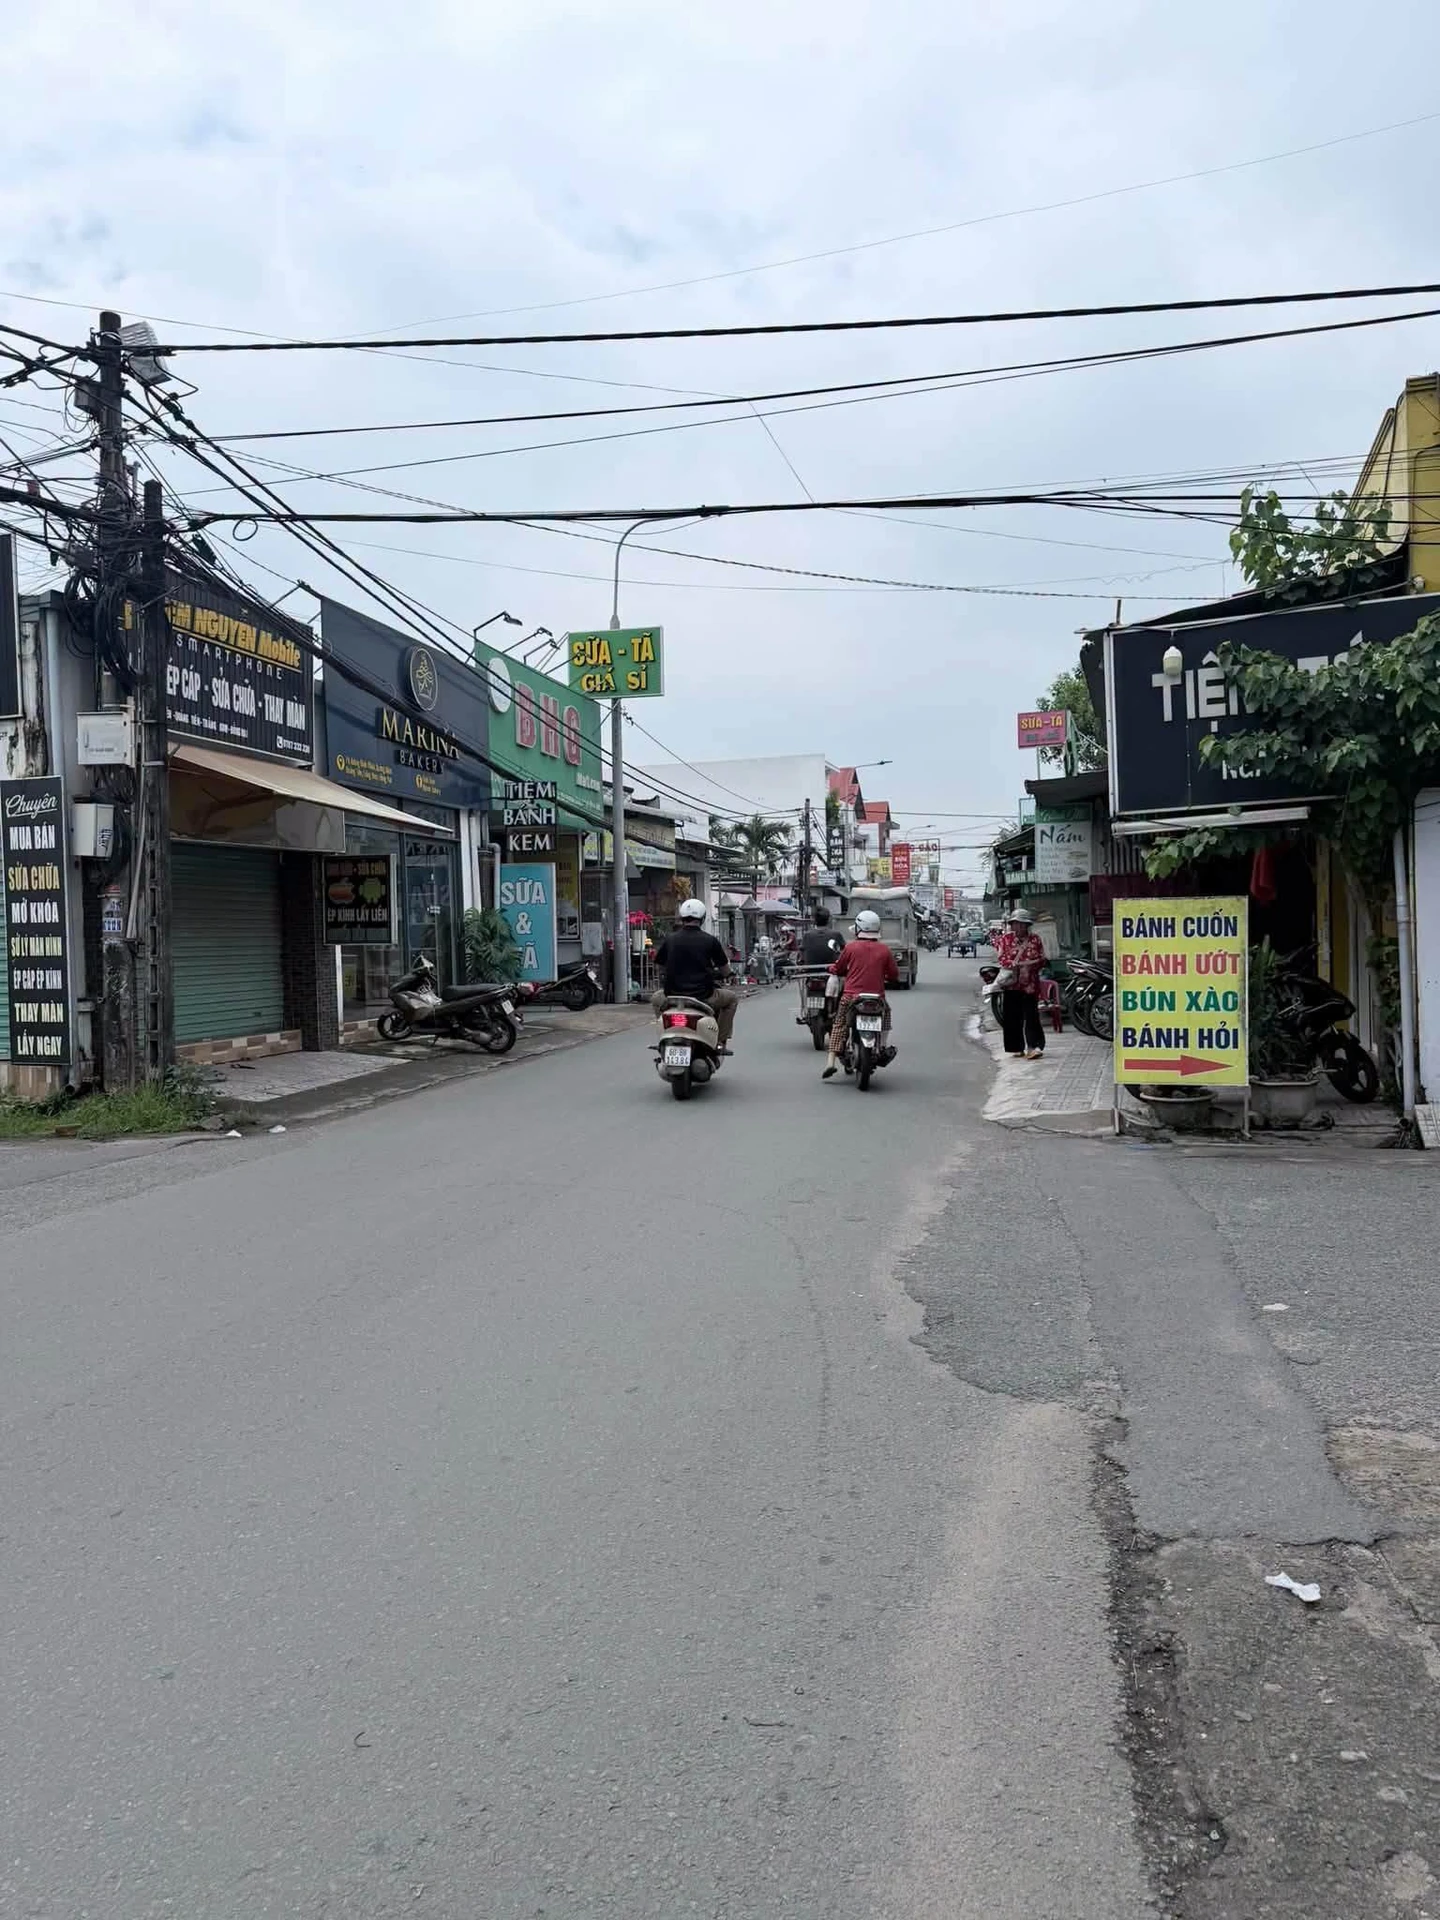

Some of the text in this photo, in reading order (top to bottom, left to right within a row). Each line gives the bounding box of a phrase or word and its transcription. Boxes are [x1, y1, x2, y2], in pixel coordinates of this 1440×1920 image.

[258, 629, 301, 667] Mobile
[572, 636, 611, 667] SỮA
[632, 633, 654, 663] TÃ
[581, 664, 647, 693] GIÁ SỈ
[181, 664, 201, 702] CÁP
[264, 693, 284, 725] THAY
[286, 695, 306, 731] MÀN
[400, 750, 445, 773] BAKERY
[5, 793, 58, 819] Chuyên
[503, 803, 556, 826] BÁNH
[9, 821, 56, 851] MUA BÁN
[509, 833, 551, 852] KEM
[1040, 824, 1086, 844] Nấm
[8, 861, 60, 891] SỬA CHỮA
[501, 877, 547, 905] SỮA
[11, 897, 59, 924] MỞ KHÓA
[1122, 908, 1238, 938] BÁNH CUỐN
[29, 934, 45, 957] MÀN
[45, 933, 62, 957] HÌNH
[1122, 949, 1241, 975] BÁNH ƯỚT
[13, 967, 62, 990] ÉP CÁP ÉP KÍNH
[14, 999, 64, 1023] THAY MÀN
[1122, 986, 1239, 1012] BÚN XÀO
[17, 1029, 62, 1056] LẤY NGAY
[1122, 1020, 1239, 1050] BÁNH HỎI
